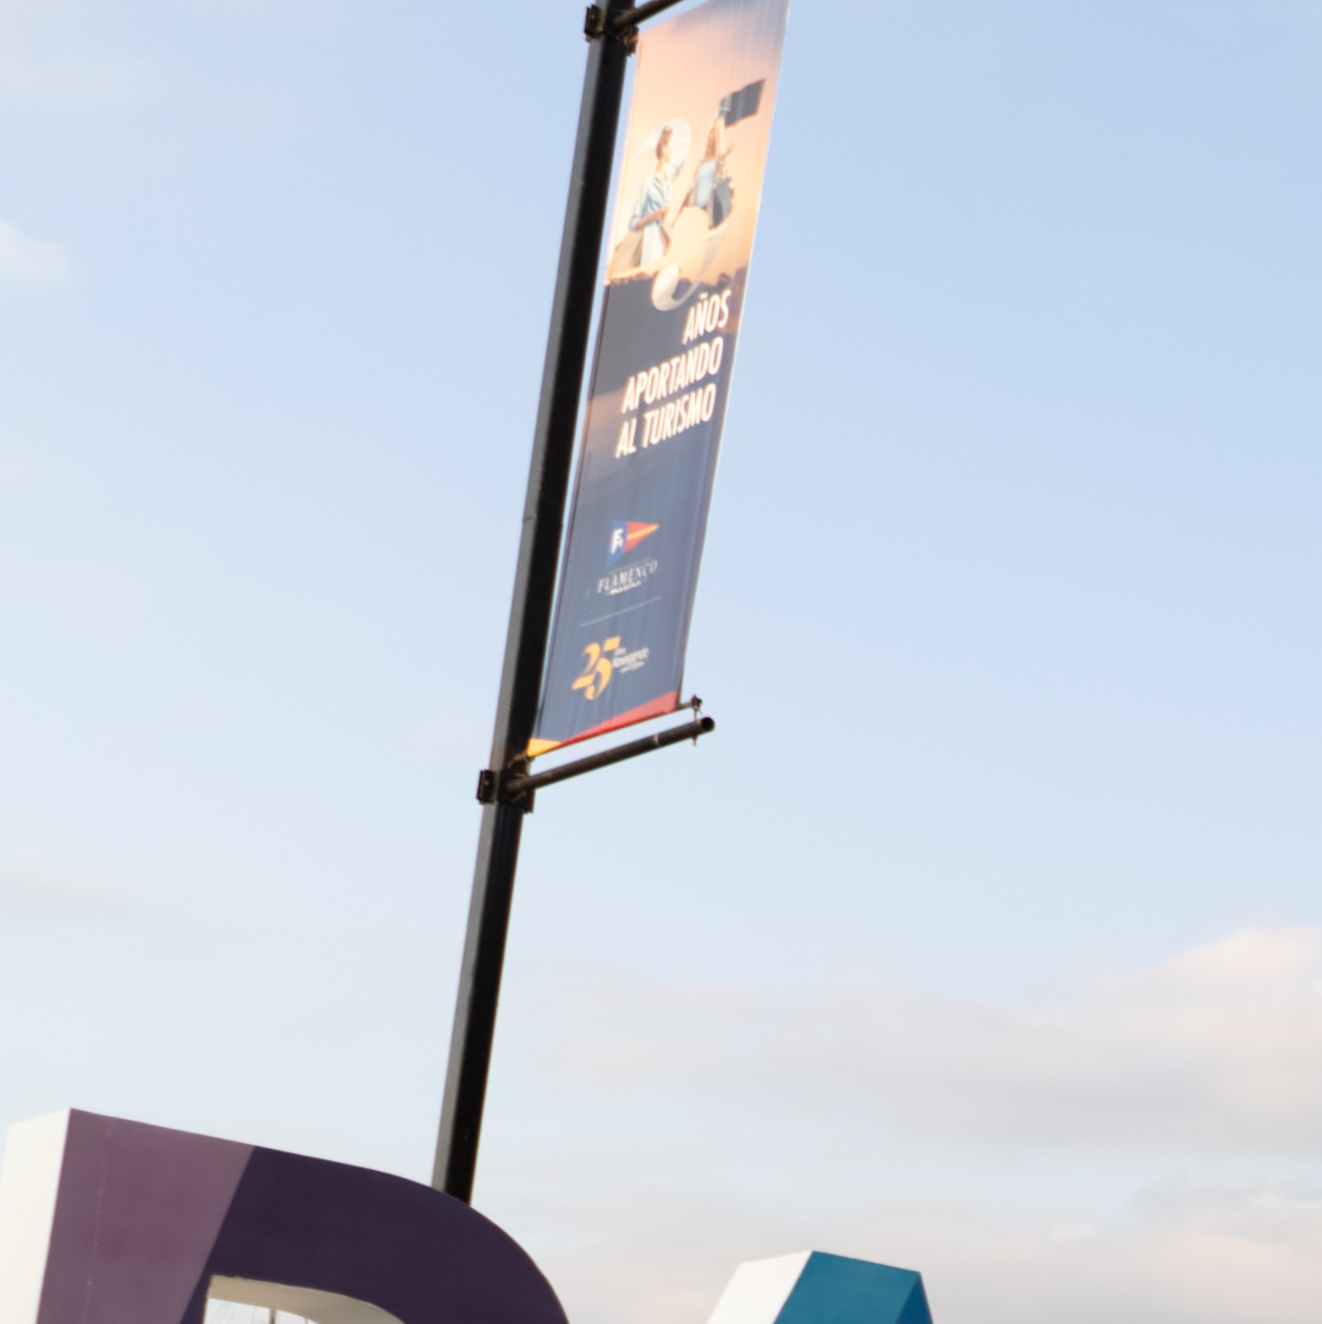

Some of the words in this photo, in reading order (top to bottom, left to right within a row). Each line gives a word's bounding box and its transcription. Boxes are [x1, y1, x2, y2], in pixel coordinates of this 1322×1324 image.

[682, 289, 731, 345] AÑOS
[621, 336, 724, 414] APORTANDO
[614, 418, 637, 459] AL
[642, 383, 716, 448] TURISMO
[597, 560, 658, 594] FLAMENCO
[571, 636, 621, 700] 25
